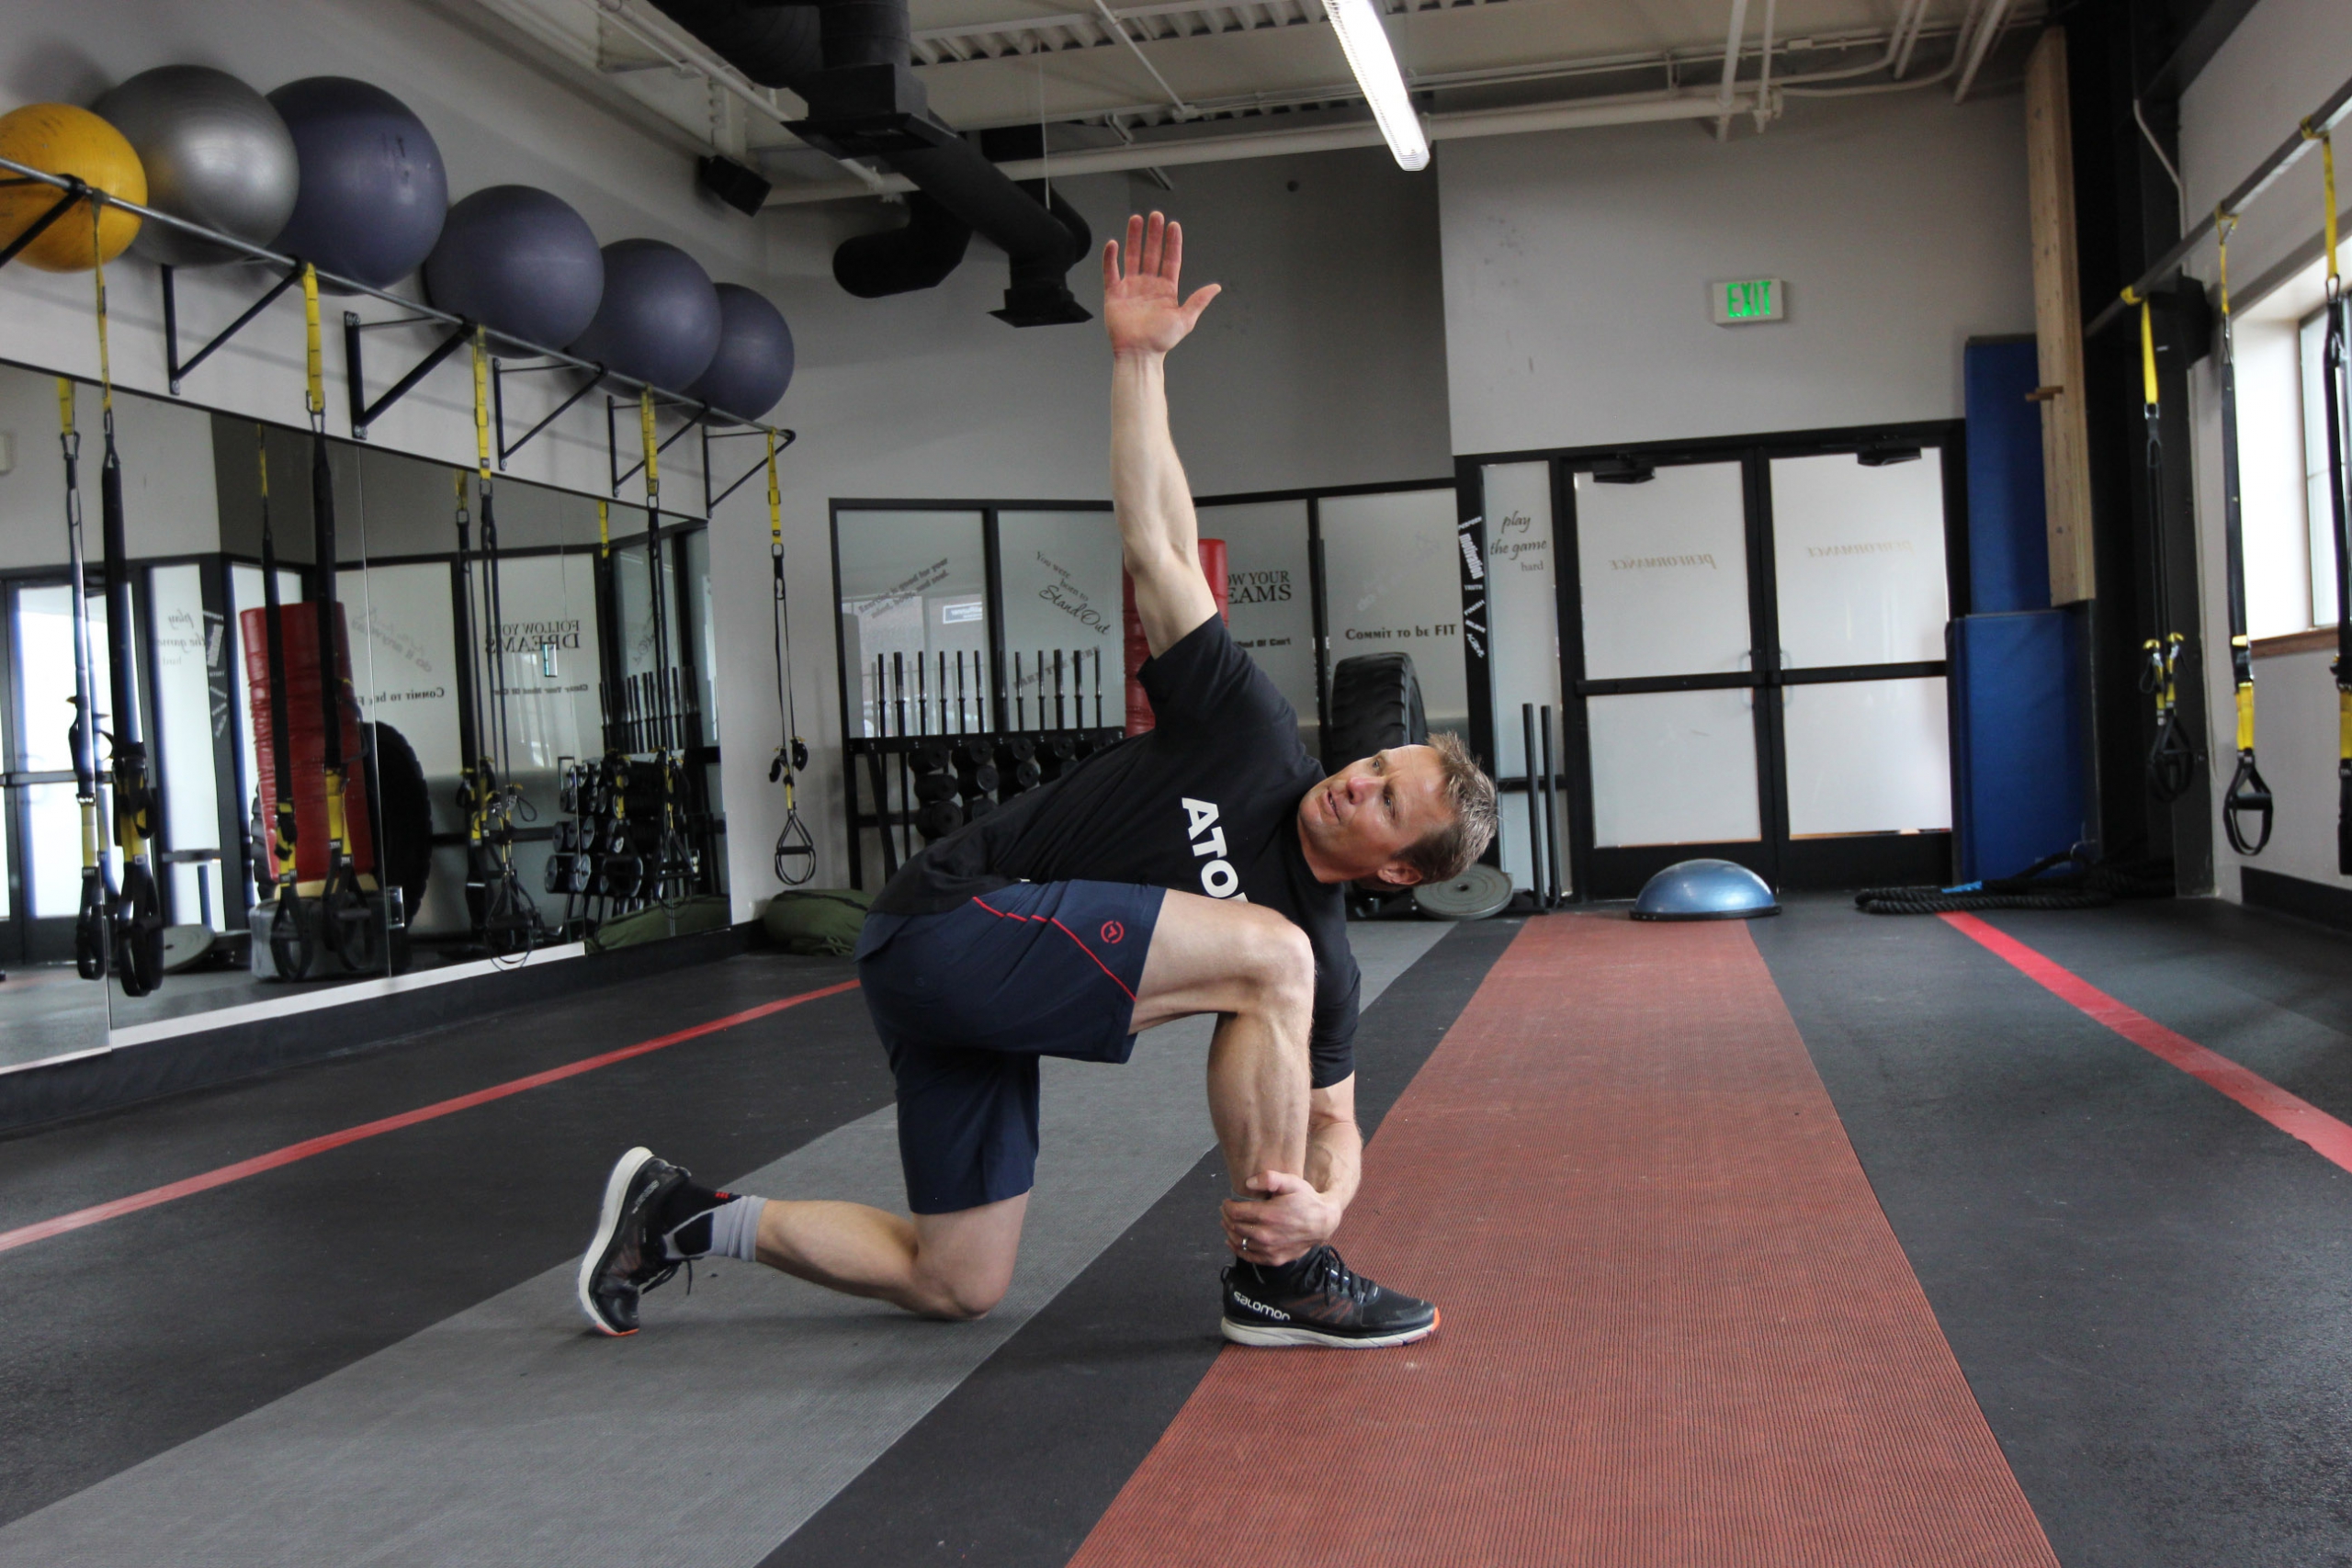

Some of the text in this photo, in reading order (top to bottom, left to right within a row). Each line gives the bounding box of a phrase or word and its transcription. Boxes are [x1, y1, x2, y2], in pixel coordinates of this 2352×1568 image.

[1726, 280, 1771, 318] EXIT
[1501, 511, 1531, 534] play
[1036, 551, 1052, 567] You
[1489, 538, 1547, 560] the game
[1521, 560, 1544, 571] hard
[1249, 570, 1290, 585] YOUR
[1227, 584, 1292, 604] EAMS
[1038, 584, 1111, 635] Stand Out
[1435, 624, 1457, 637] FIT
[1182, 797, 1250, 903] ATO
